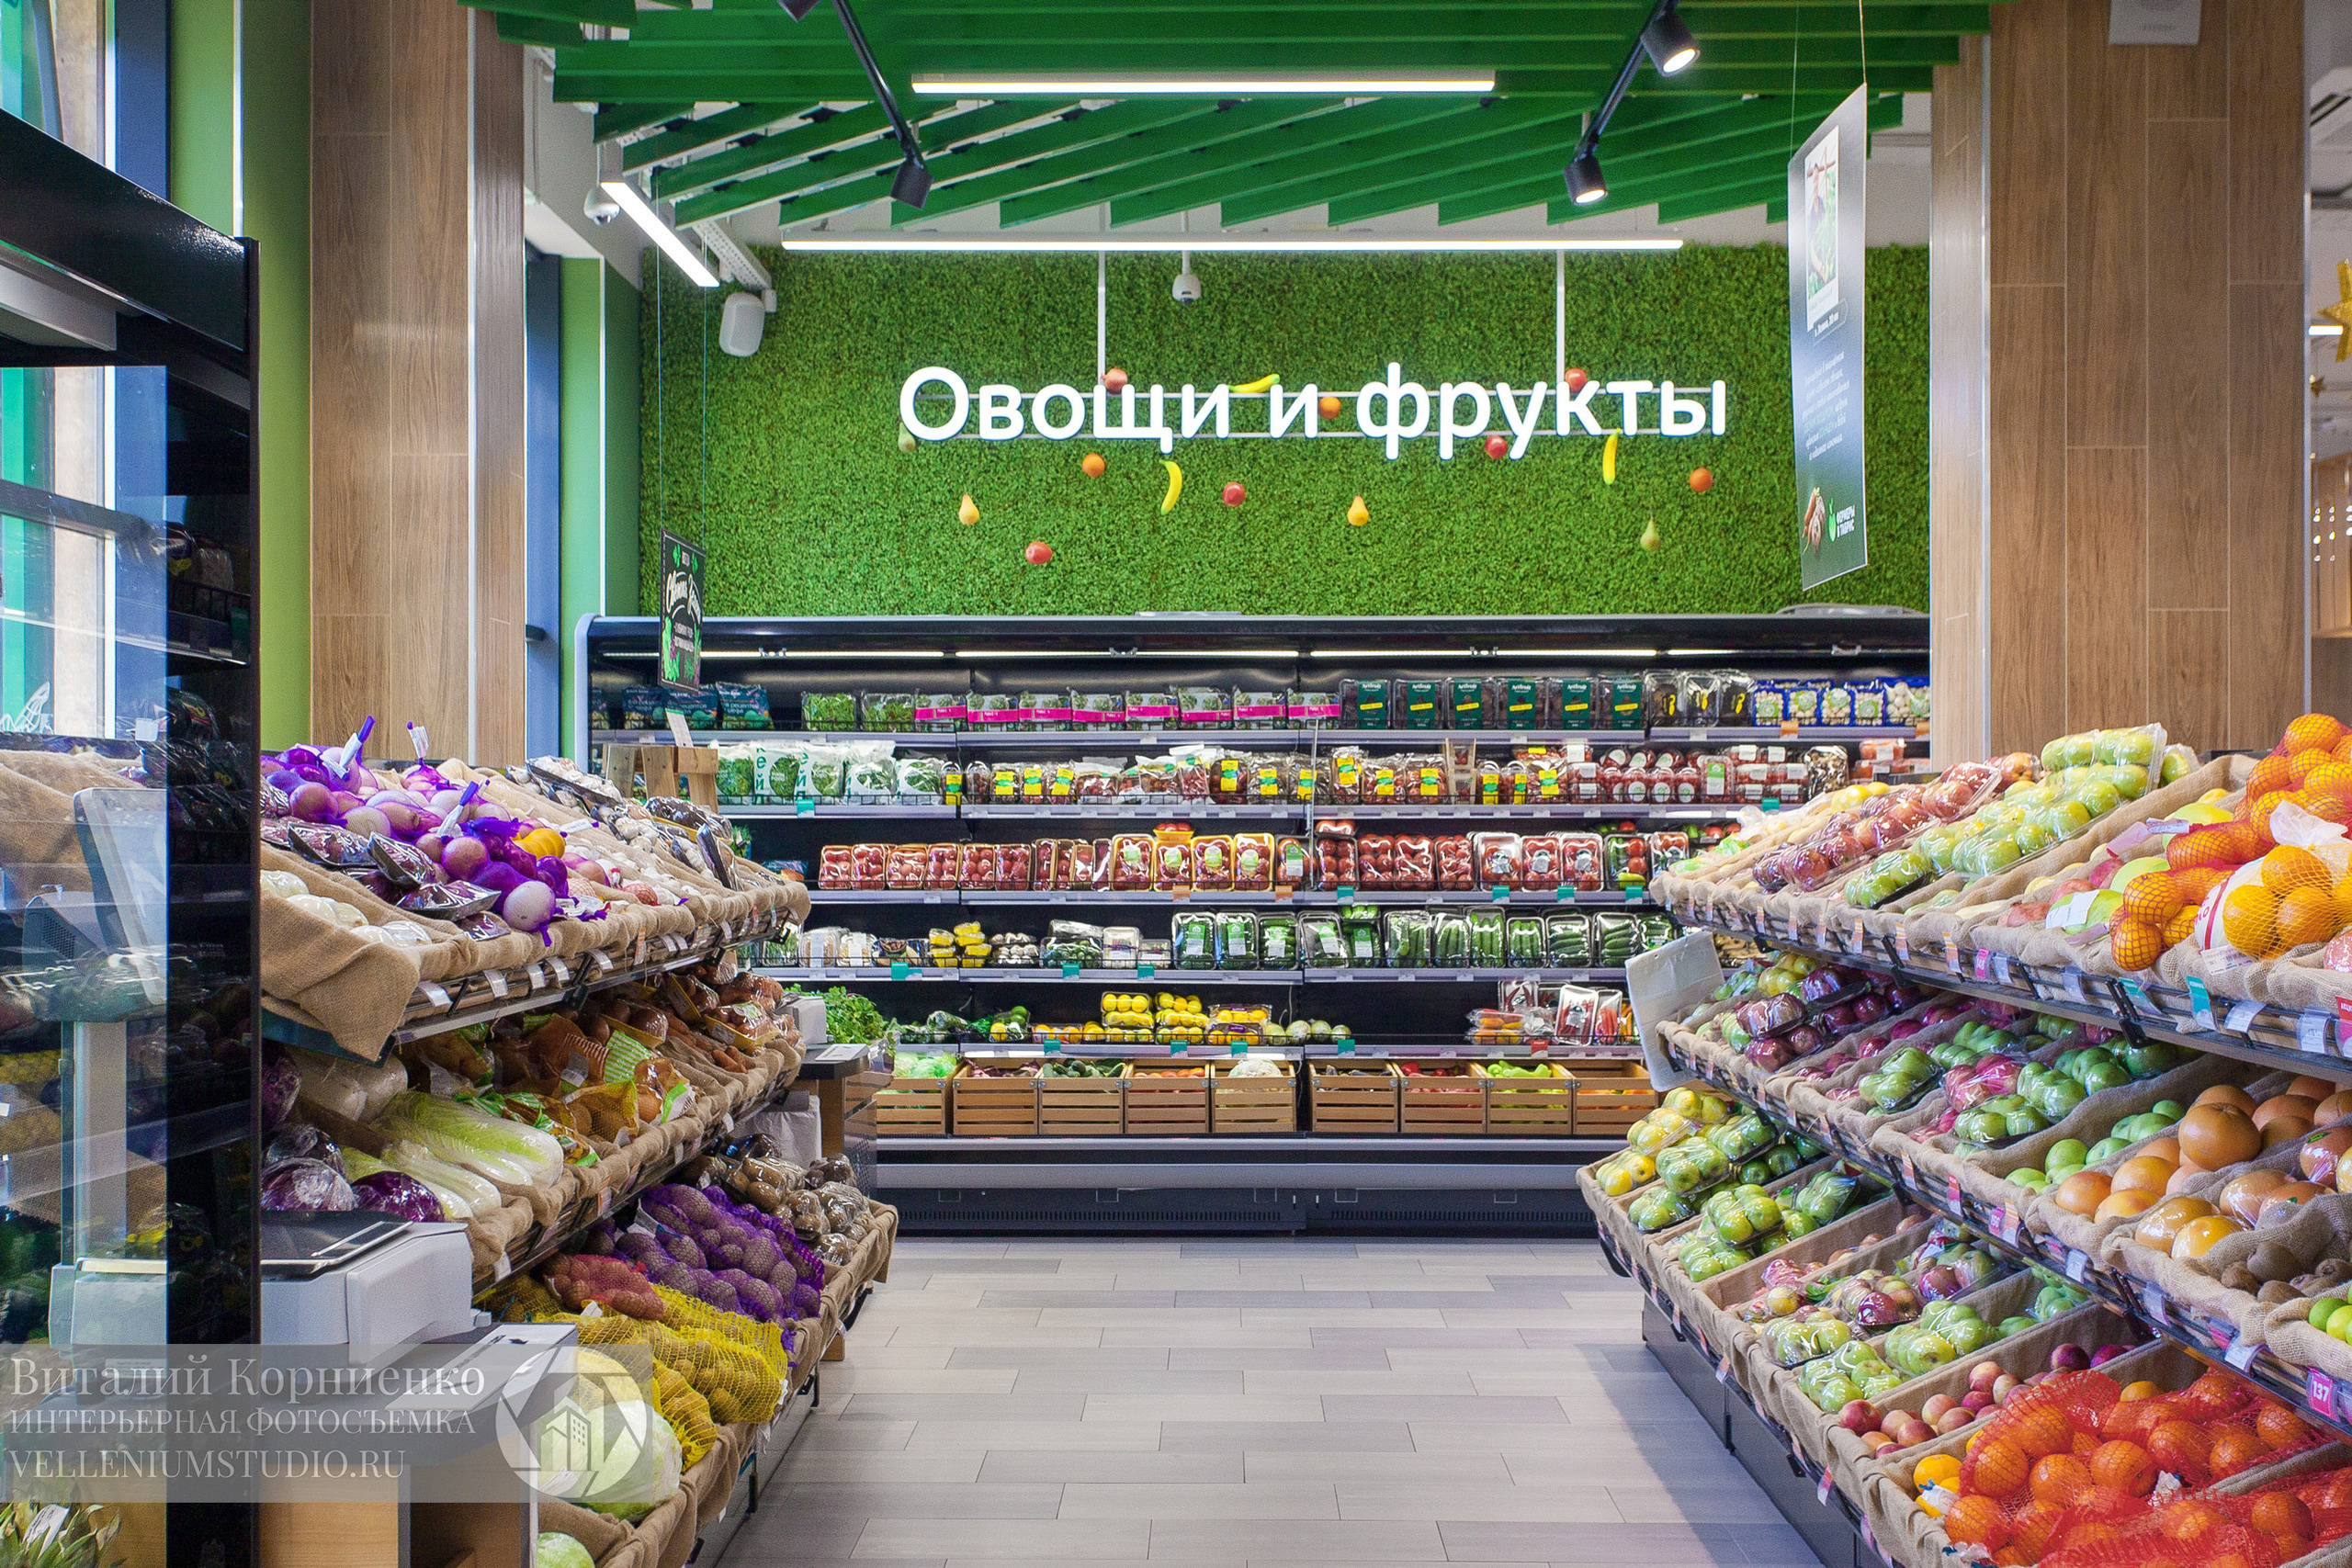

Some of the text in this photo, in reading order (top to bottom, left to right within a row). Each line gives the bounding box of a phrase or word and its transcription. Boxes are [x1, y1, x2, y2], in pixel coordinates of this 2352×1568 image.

[898, 366, 1234, 454] Овощи
[1269, 383, 1319, 439] и
[1354, 361, 1727, 460] фрукты
[2312, 1381, 2330, 1403] 137
